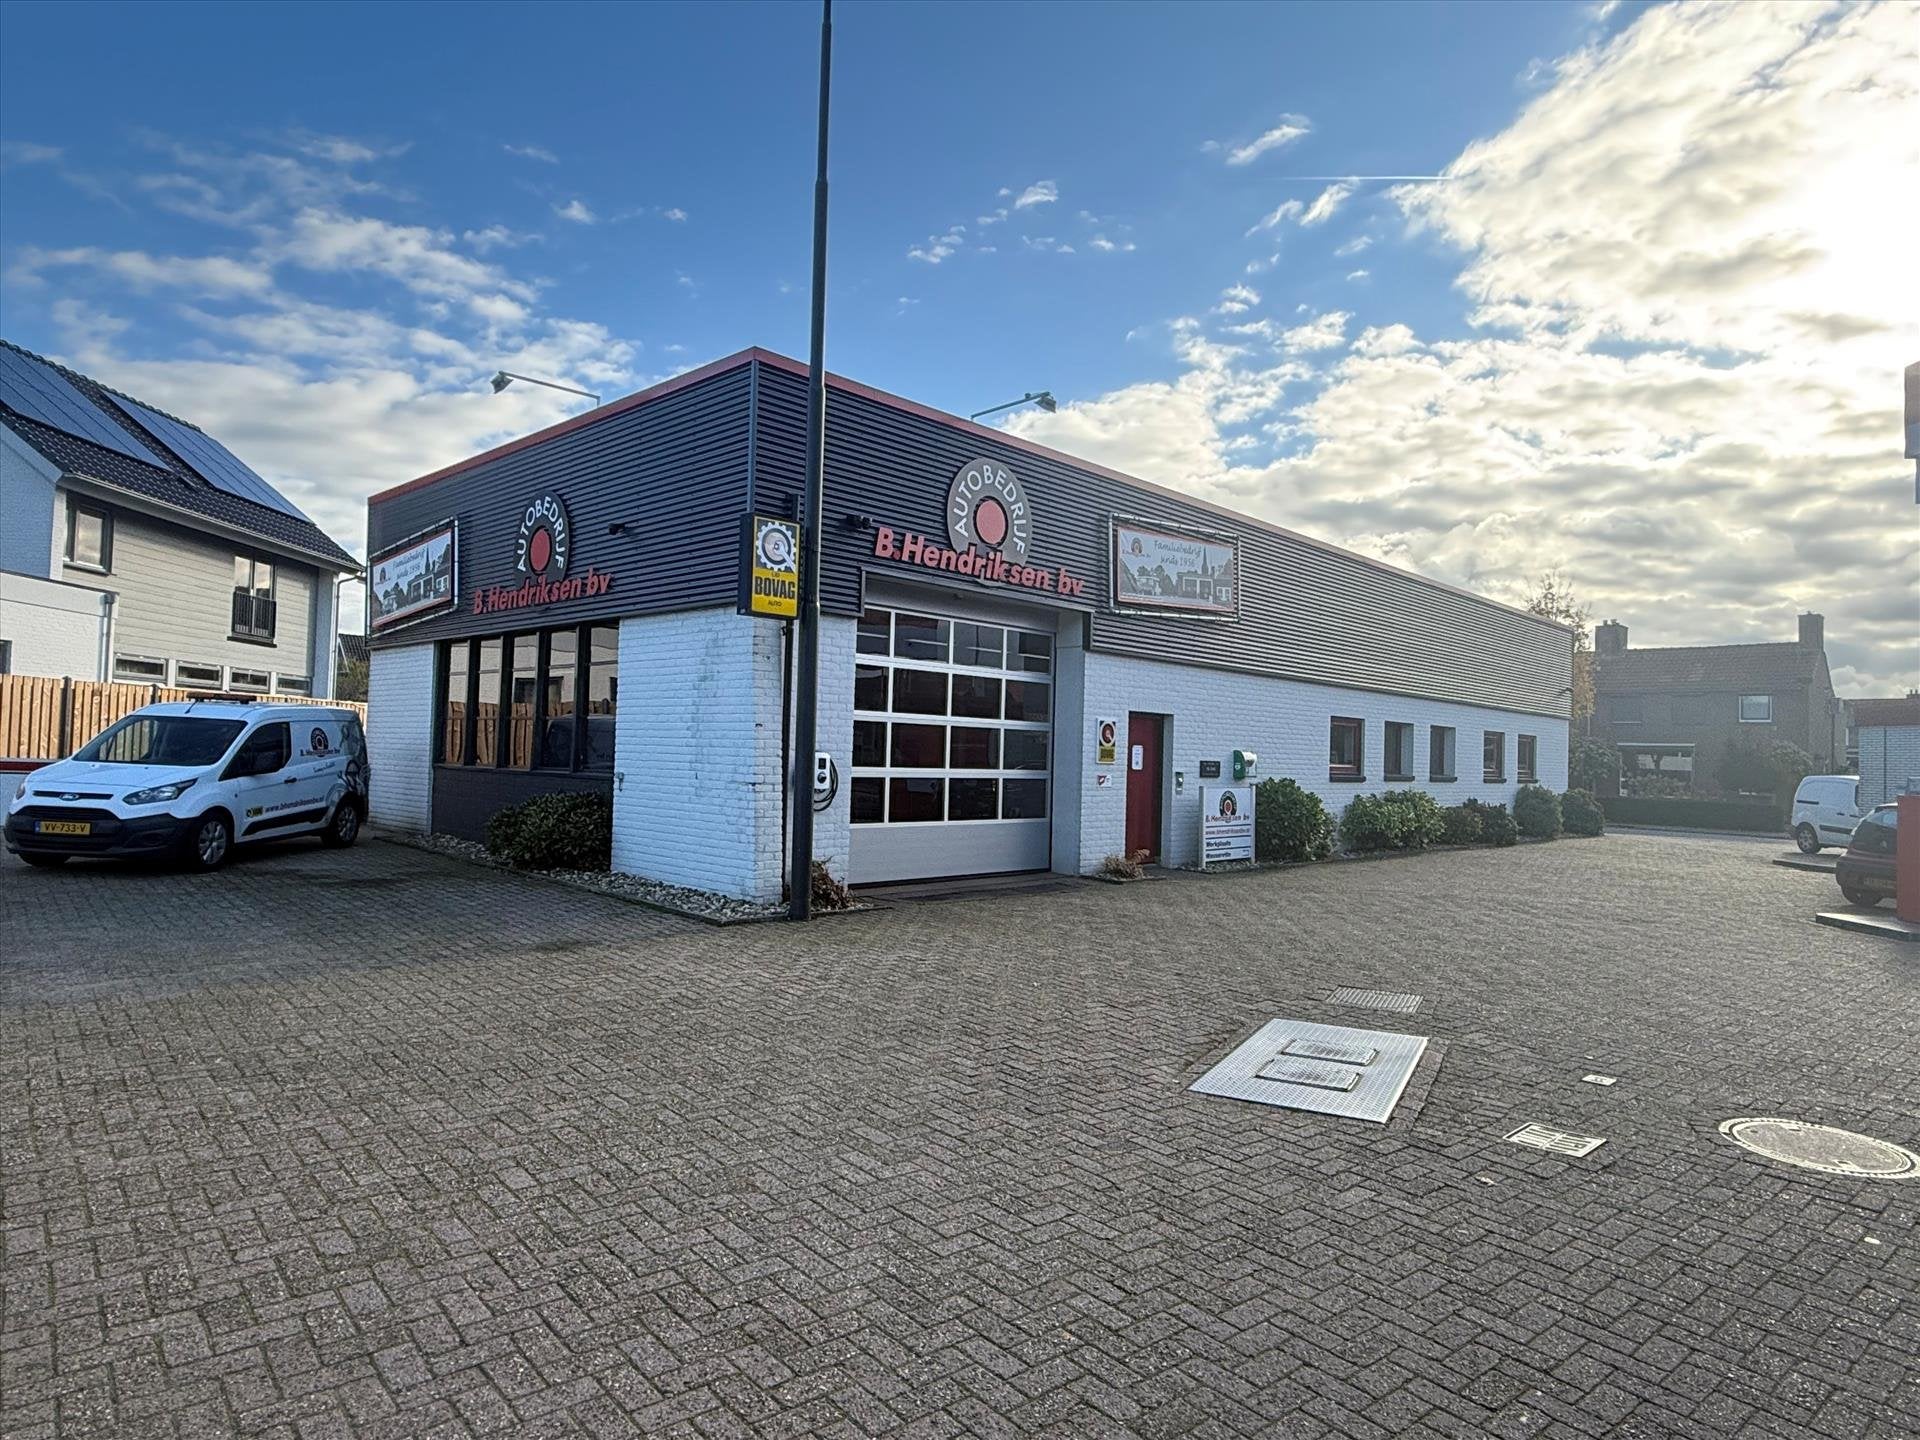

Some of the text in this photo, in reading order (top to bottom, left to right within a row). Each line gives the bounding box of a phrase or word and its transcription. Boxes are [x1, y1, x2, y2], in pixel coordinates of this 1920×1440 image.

[953, 465, 1026, 554] AUTOBEDRIJF
[517, 496, 566, 572] AUTOBEDRIJF
[587, 568, 611, 597] bv
[754, 575, 796, 600] BOVAG
[1057, 567, 1085, 596] bv
